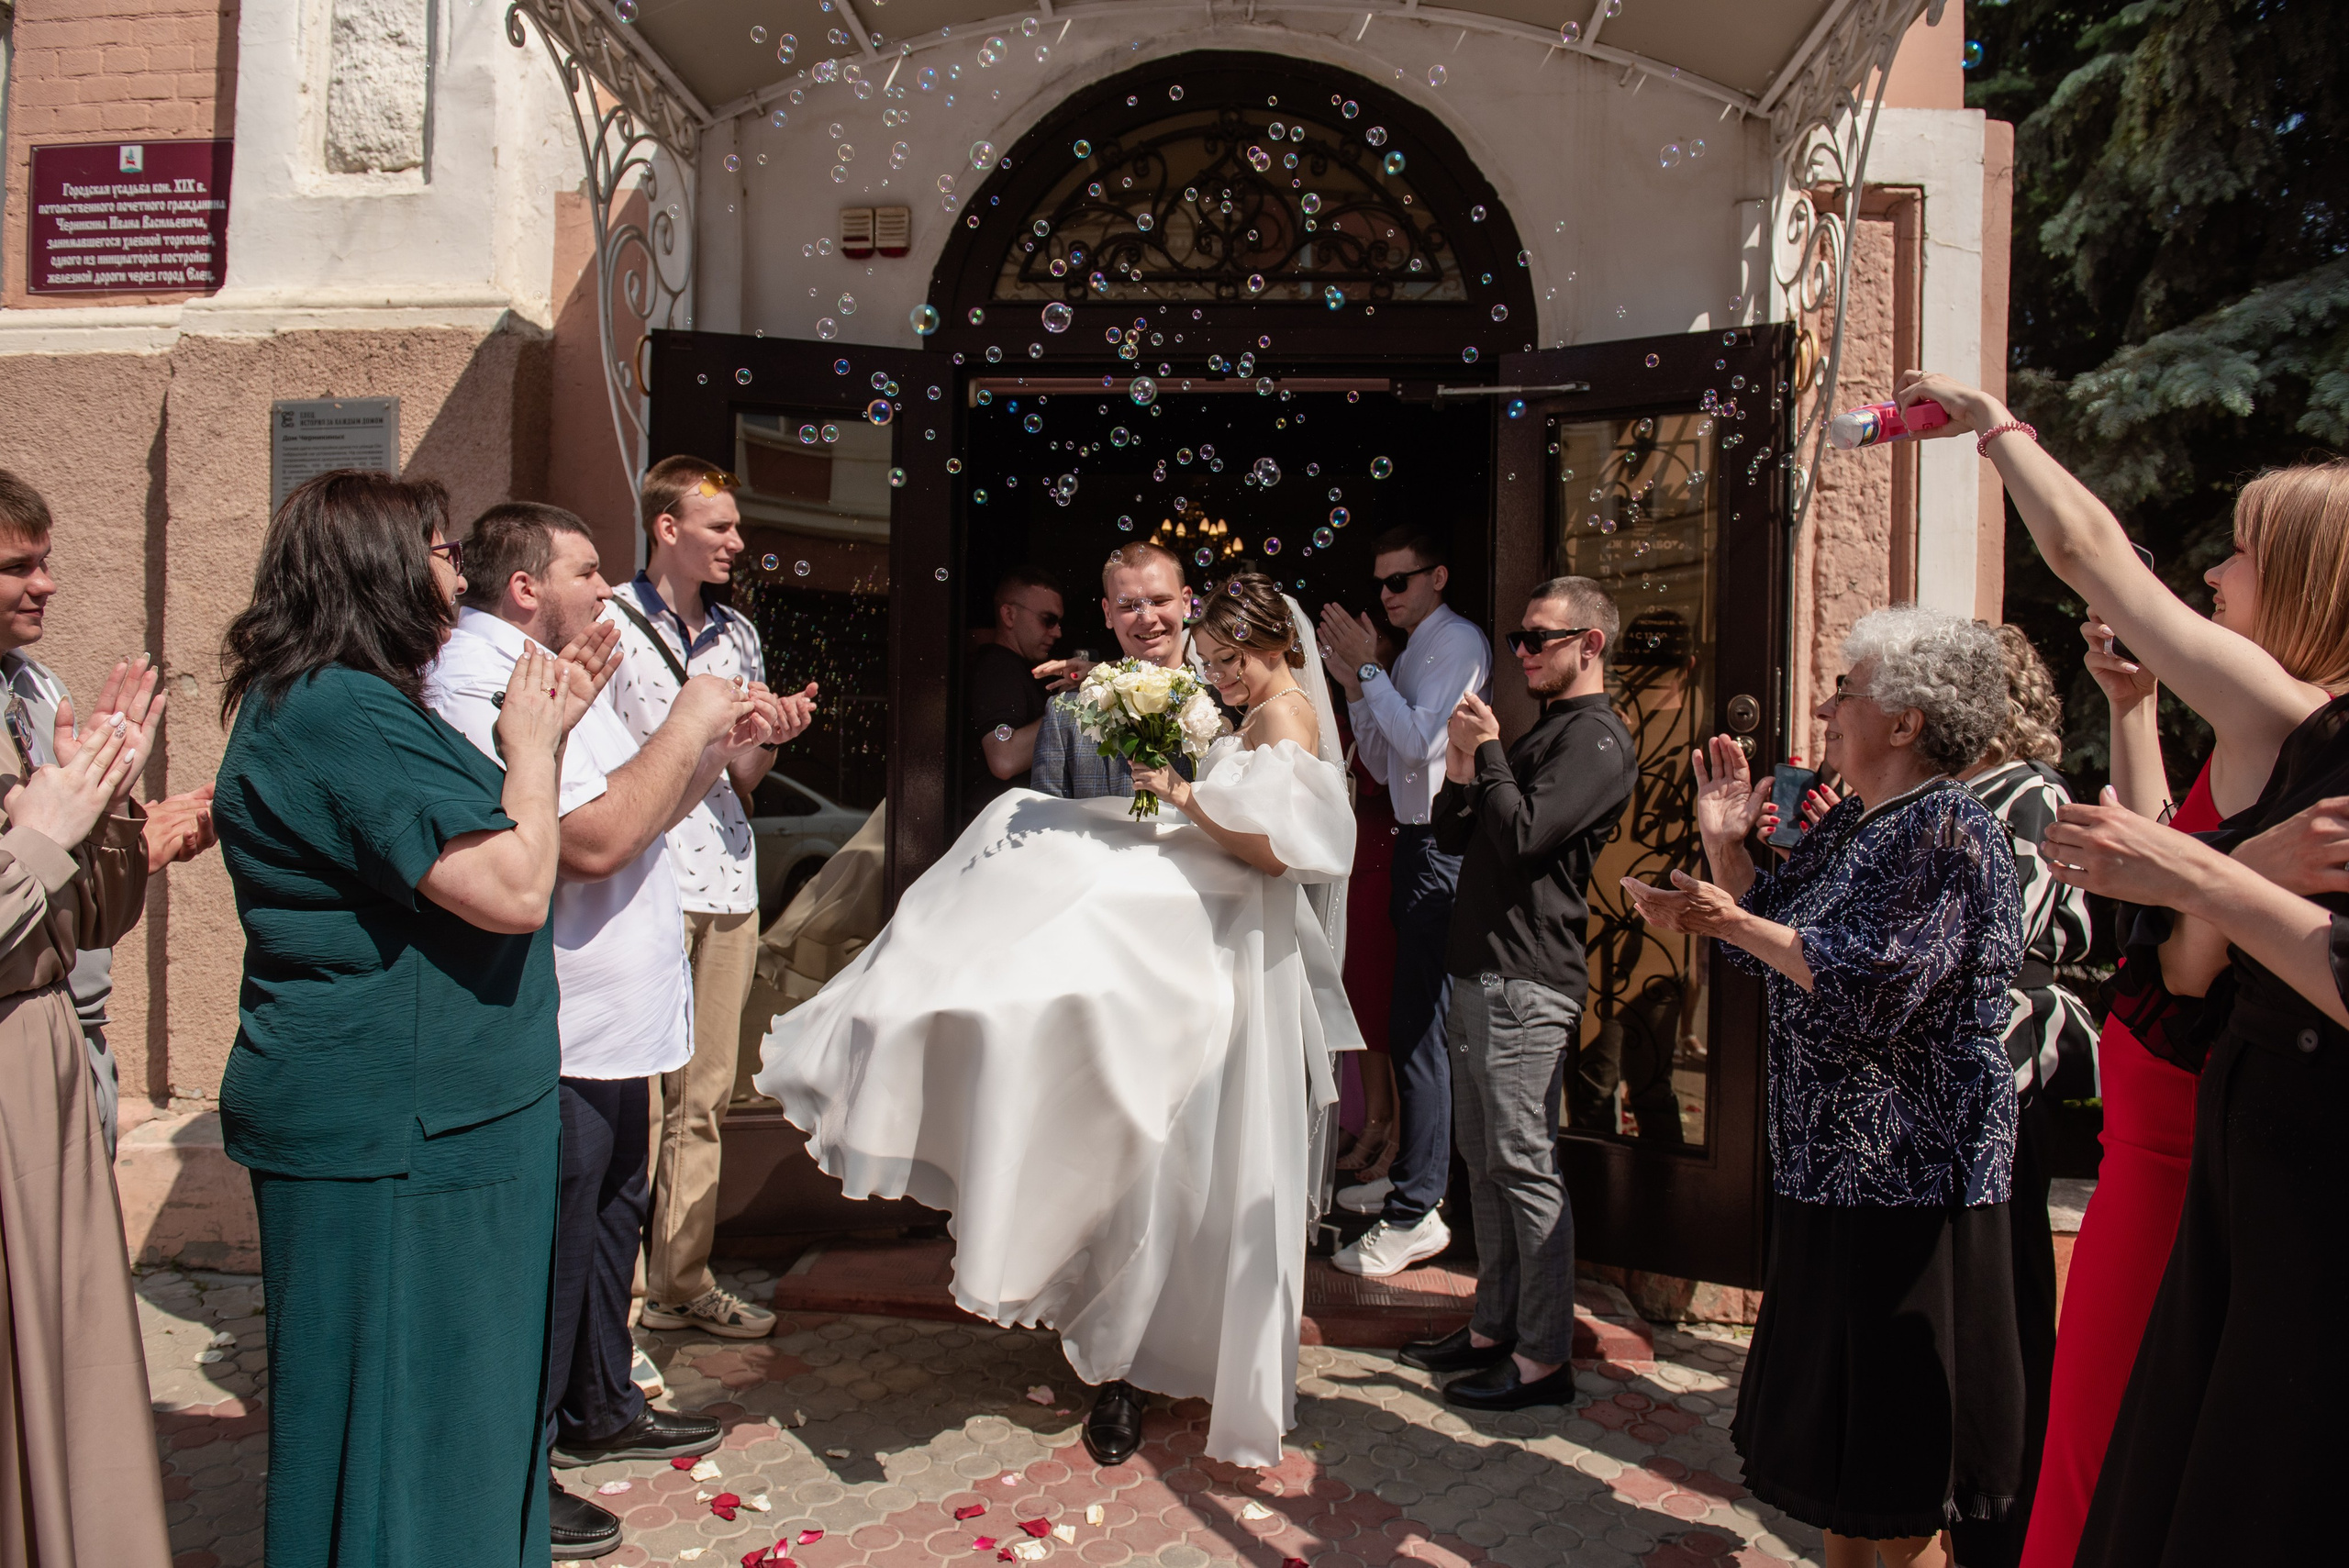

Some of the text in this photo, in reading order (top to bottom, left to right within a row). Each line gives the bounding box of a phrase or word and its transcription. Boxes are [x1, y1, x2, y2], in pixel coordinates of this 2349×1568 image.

[62, 178, 207, 200] Городская усадьба кон. XIX в.
[39, 199, 227, 215] потомственного почетного гражданина
[55, 215, 207, 235] Черникина Ивана Васильевича,
[46, 232, 216, 250] занимавшегося хлебной торговлей,
[50, 250, 212, 269] одного из инициаторов постройки
[47, 270, 94, 284] железной
[94, 272, 127, 286] дороги
[128, 272, 156, 285] через
[158, 271, 185, 285] город
[362, 417, 384, 426] ДОМОМ
